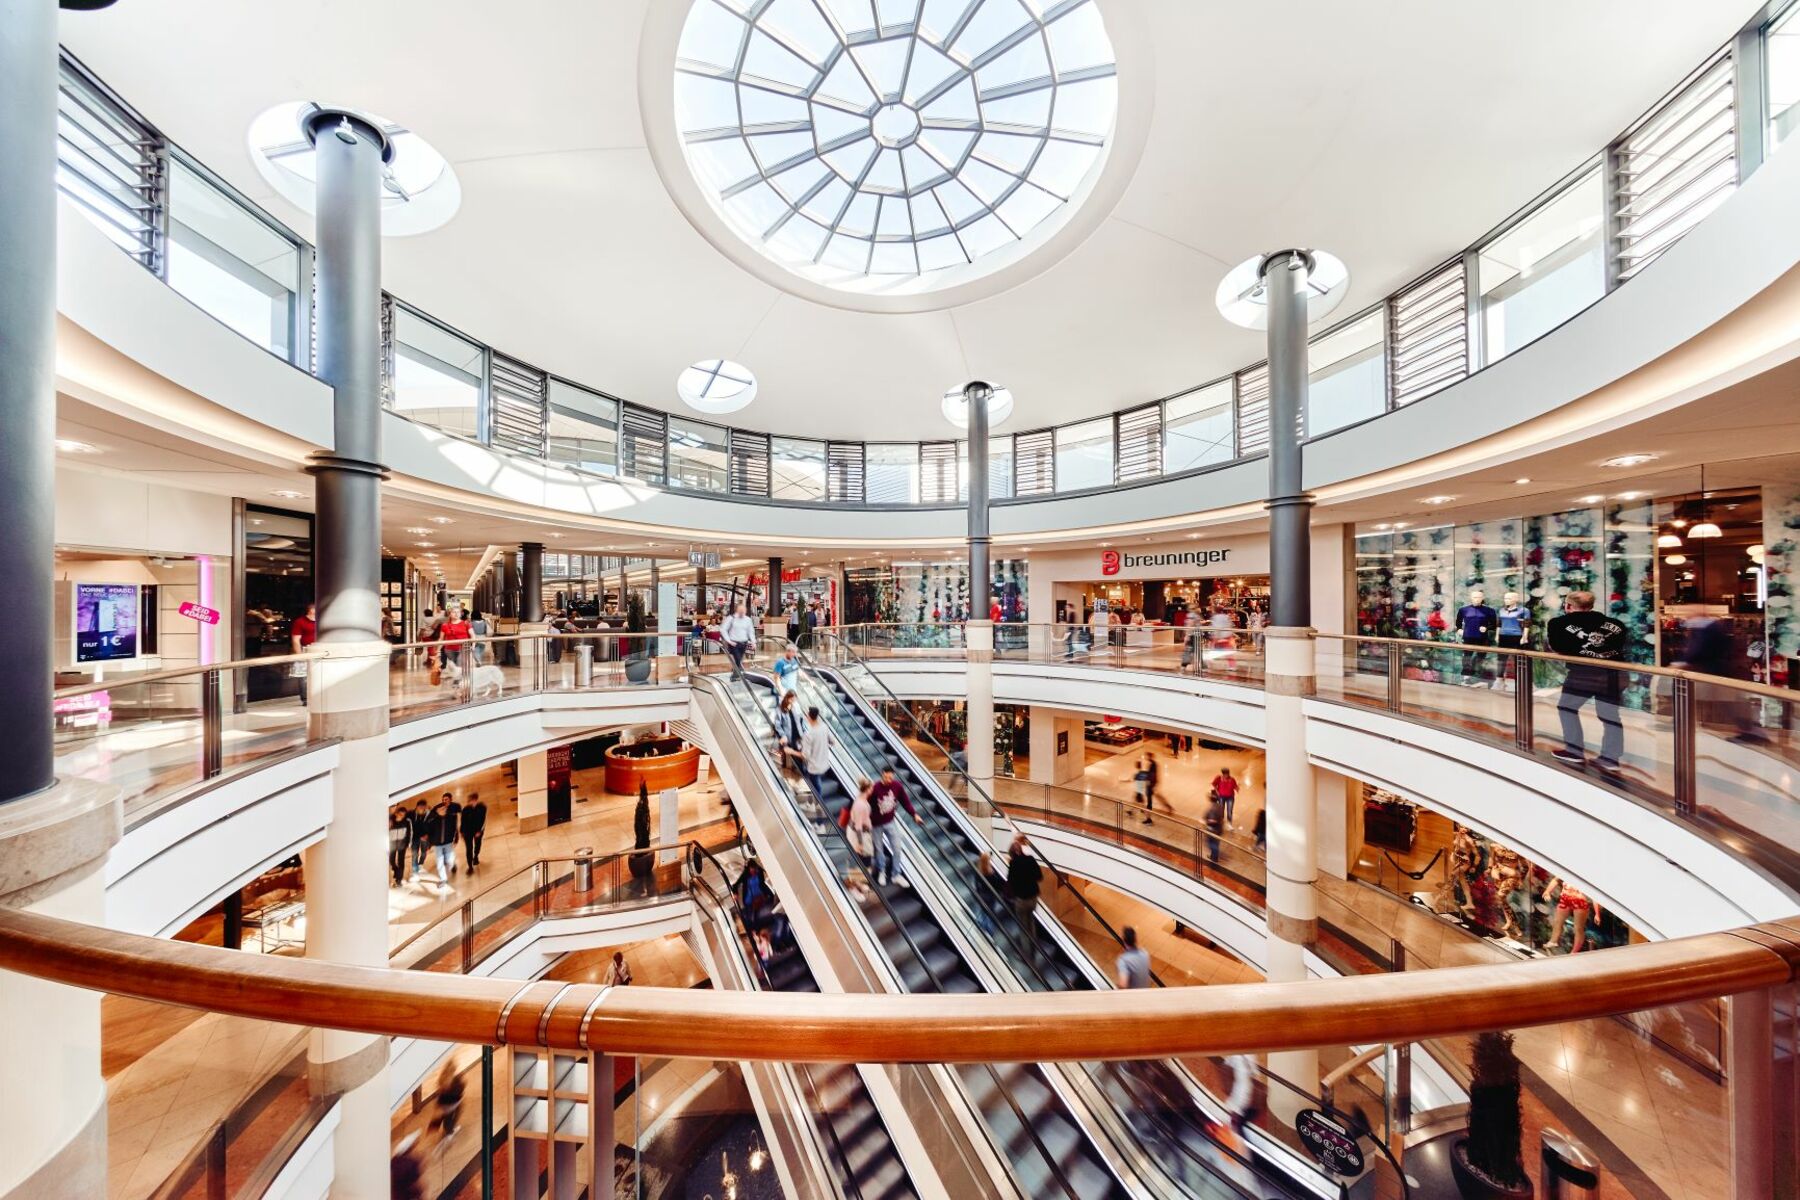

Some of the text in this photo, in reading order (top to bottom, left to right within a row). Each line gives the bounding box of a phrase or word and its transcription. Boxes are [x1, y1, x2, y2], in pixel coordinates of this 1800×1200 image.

[1124, 549, 1231, 567] breuninger
[183, 609, 211, 622] #DABEI
[192, 604, 210, 614] SEID
